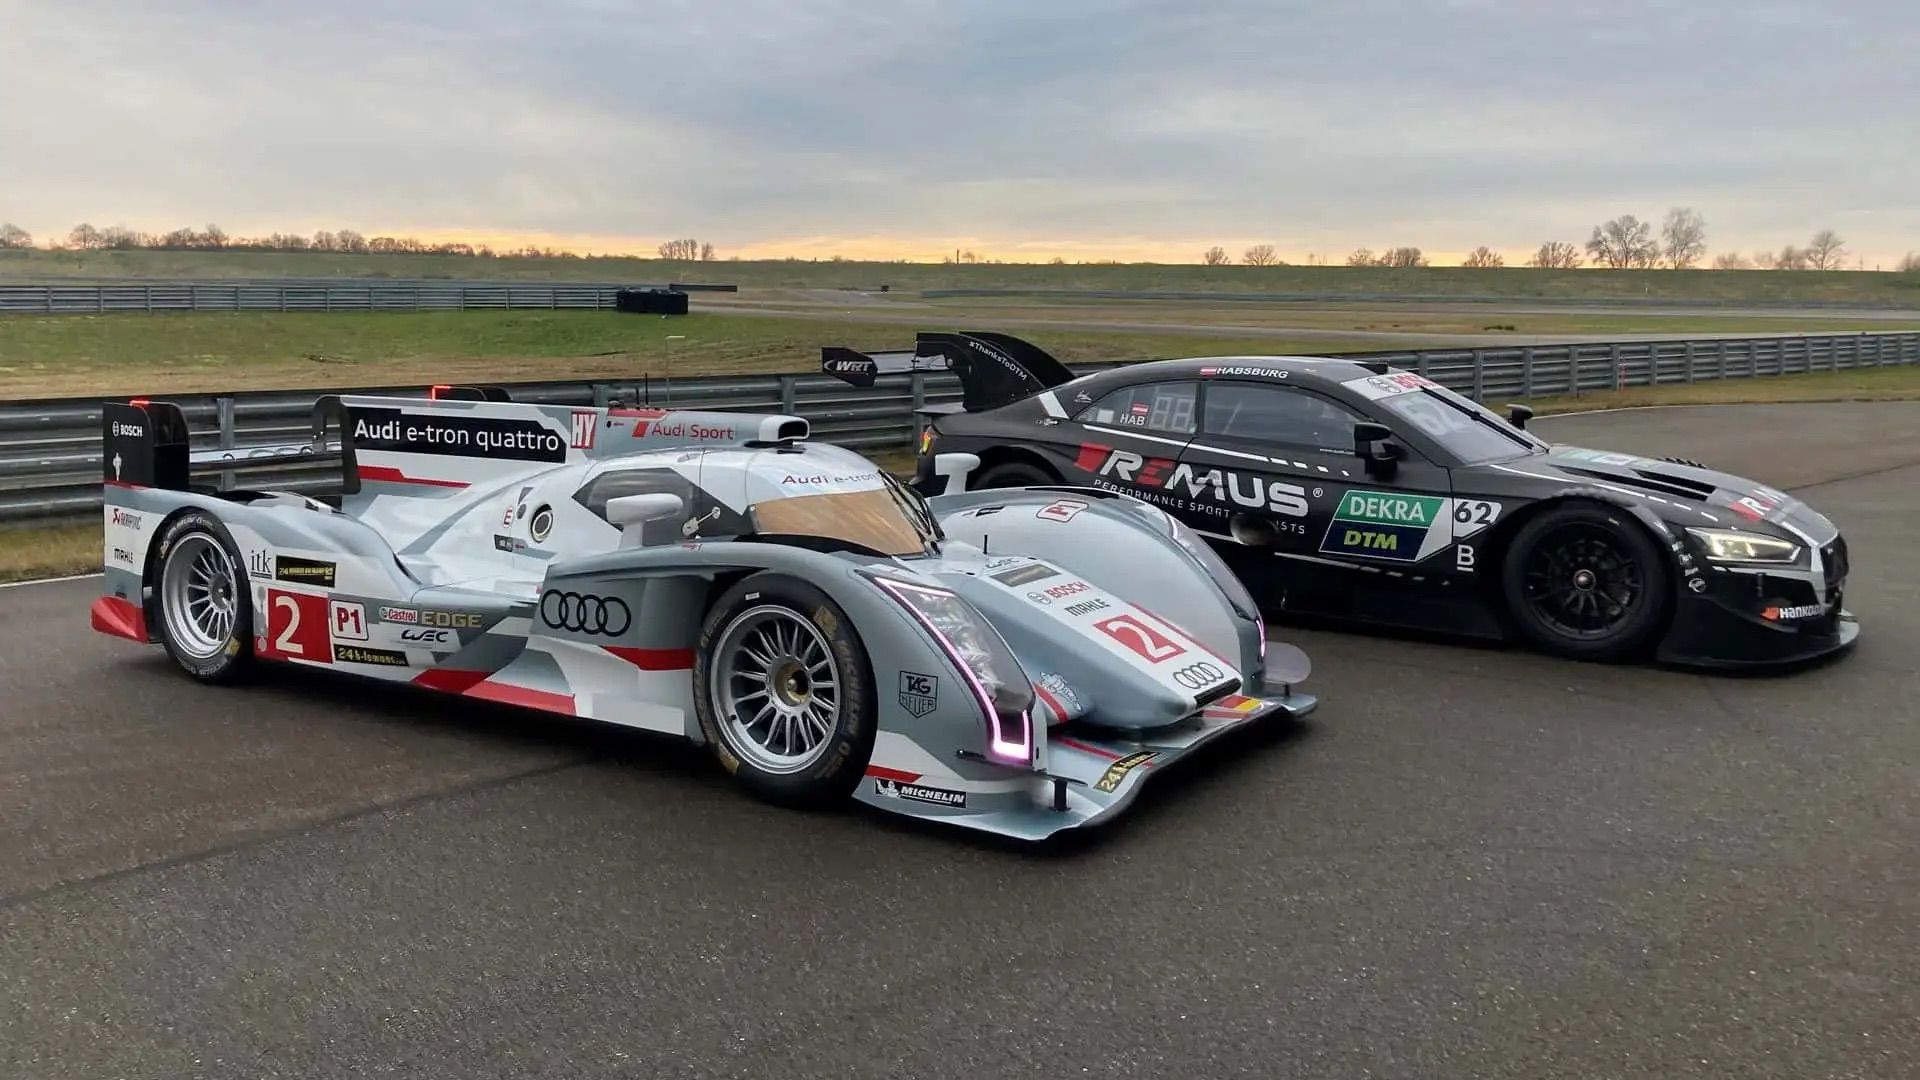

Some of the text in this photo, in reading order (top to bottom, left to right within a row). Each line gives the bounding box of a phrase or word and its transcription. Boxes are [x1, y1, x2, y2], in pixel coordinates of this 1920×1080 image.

[835, 360, 873, 372] WRT
[969, 341, 1028, 381] #ThanksToDTM
[1216, 367, 1288, 379] HABSBURG
[1119, 413, 1146, 426] HAB
[120, 424, 143, 437] BOSCH
[354, 418, 560, 451] Audi e-tron quattro
[571, 414, 596, 447] HY
[651, 423, 734, 440] Audi Sport
[782, 475, 829, 485] Audi
[1094, 479, 1231, 519] PERFORMANCE SPORT
[1350, 496, 1425, 522] DEKRA
[1454, 501, 1493, 525] 62
[1343, 530, 1398, 551] DTM
[251, 549, 273, 574] itk
[1457, 543, 1475, 567] B
[1043, 580, 1091, 599] BOSCH
[1063, 598, 1112, 617] MAHLE
[275, 596, 304, 655] 2
[336, 606, 362, 634] P1
[388, 608, 483, 628] Castrol EDGE
[401, 629, 449, 643] WEC
[1106, 620, 1177, 658] 2
[906, 675, 931, 695] TAG
[901, 786, 965, 803] MICHELIN
